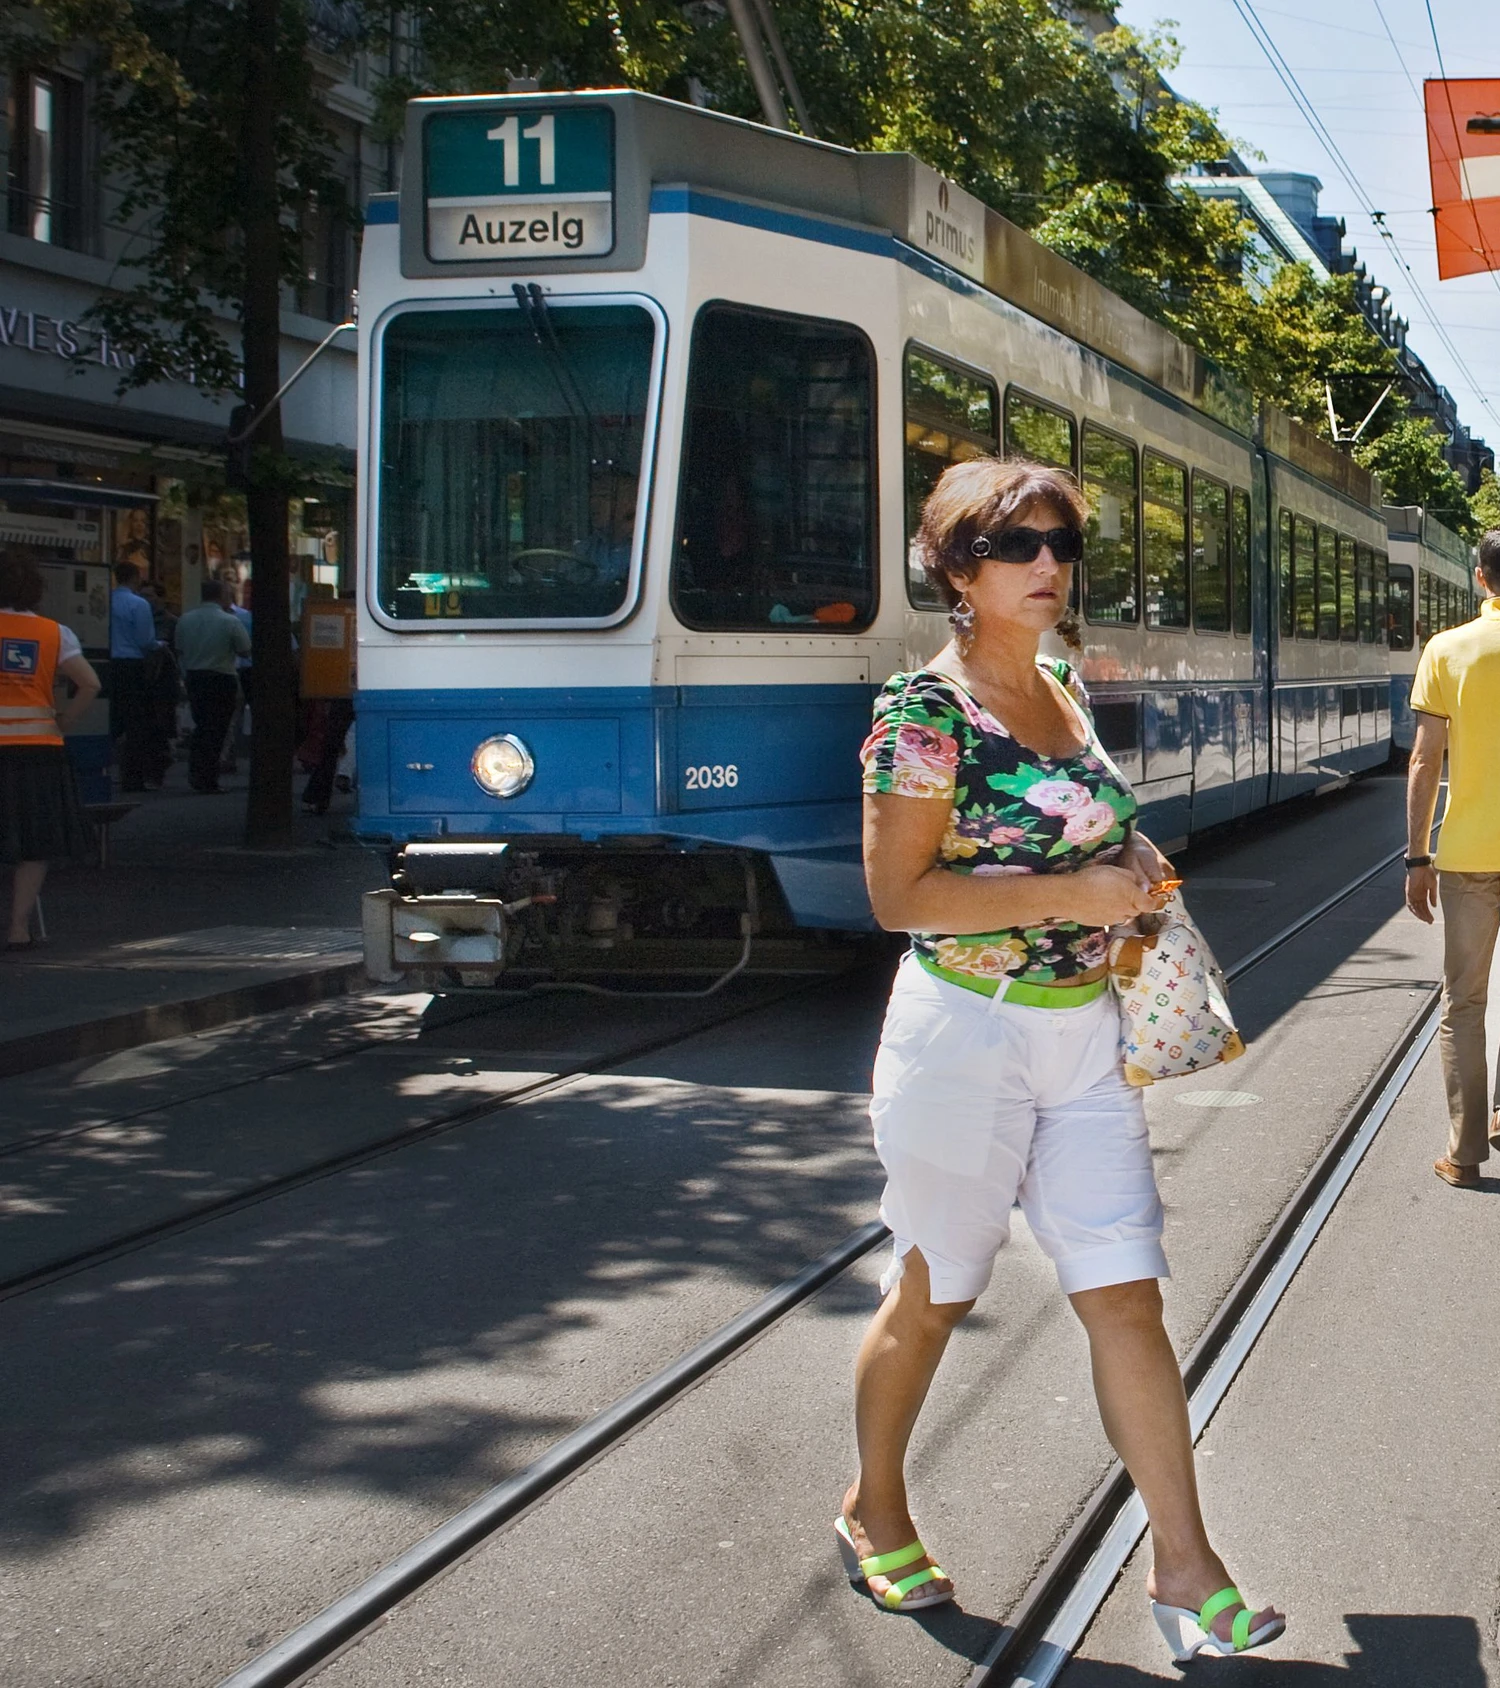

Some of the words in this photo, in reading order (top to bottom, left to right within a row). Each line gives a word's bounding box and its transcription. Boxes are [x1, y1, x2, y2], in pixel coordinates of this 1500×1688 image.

[486, 114, 556, 187] 11
[458, 211, 584, 249] Auzelg
[926, 209, 975, 264] primus
[685, 765, 738, 790] 2036
